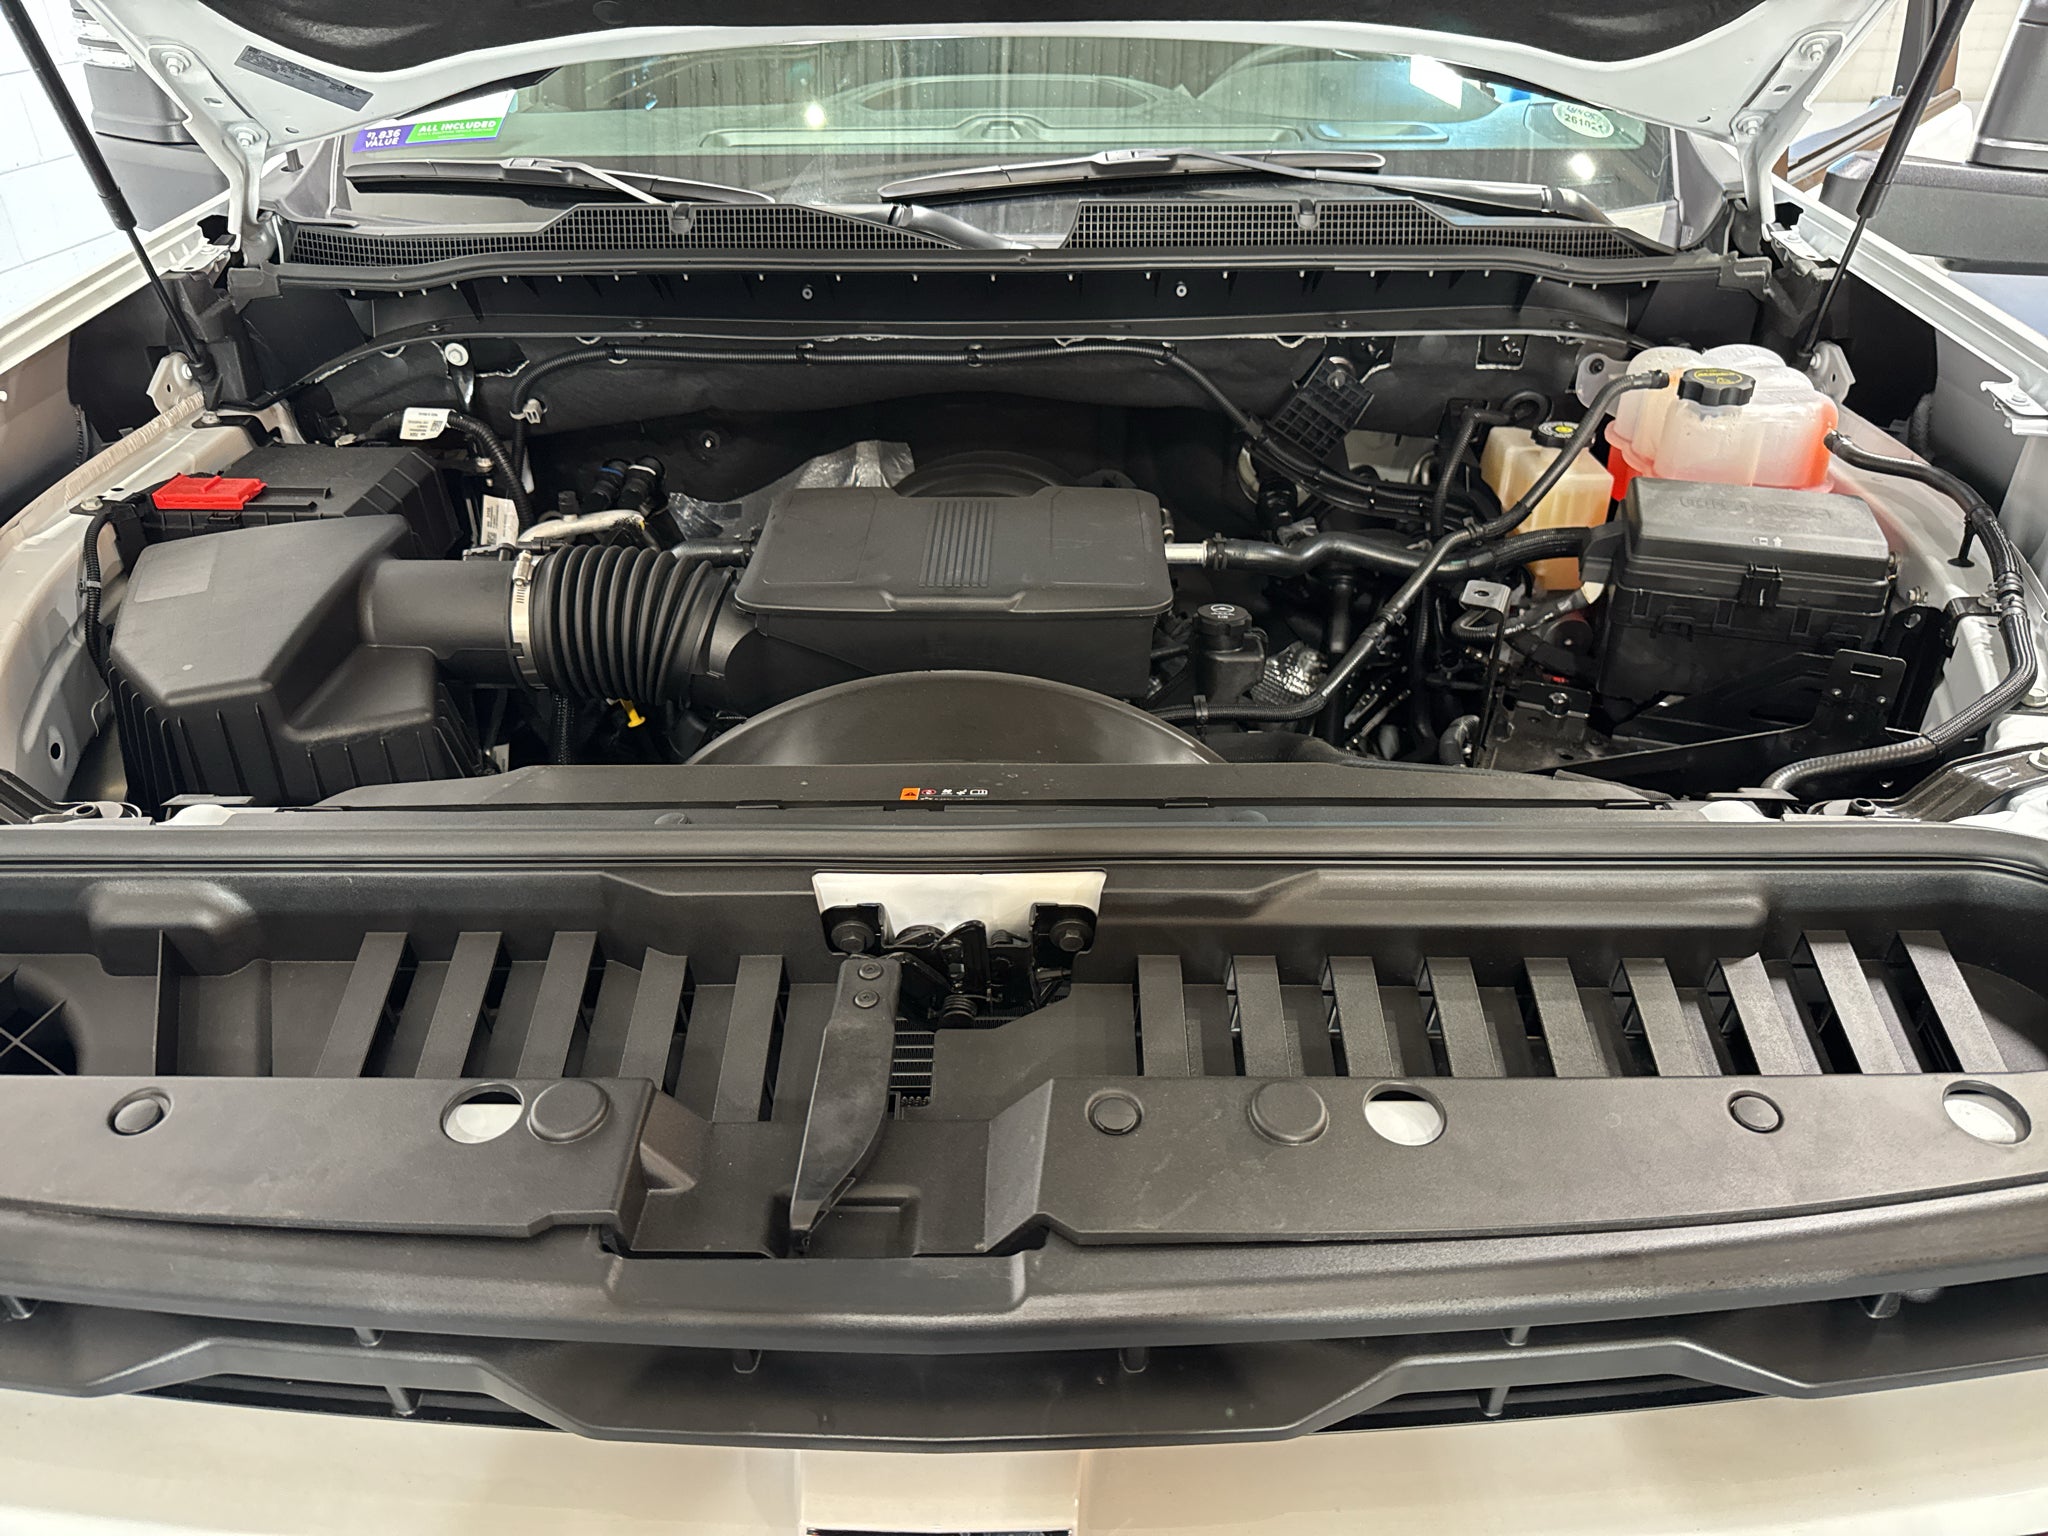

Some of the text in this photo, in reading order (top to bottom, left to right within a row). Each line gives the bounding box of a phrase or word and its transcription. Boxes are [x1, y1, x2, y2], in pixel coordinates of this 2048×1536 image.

[418, 123, 438, 133] ALL
[440, 120, 497, 131] INCLUDED
[365, 136, 400, 148] VALUE
